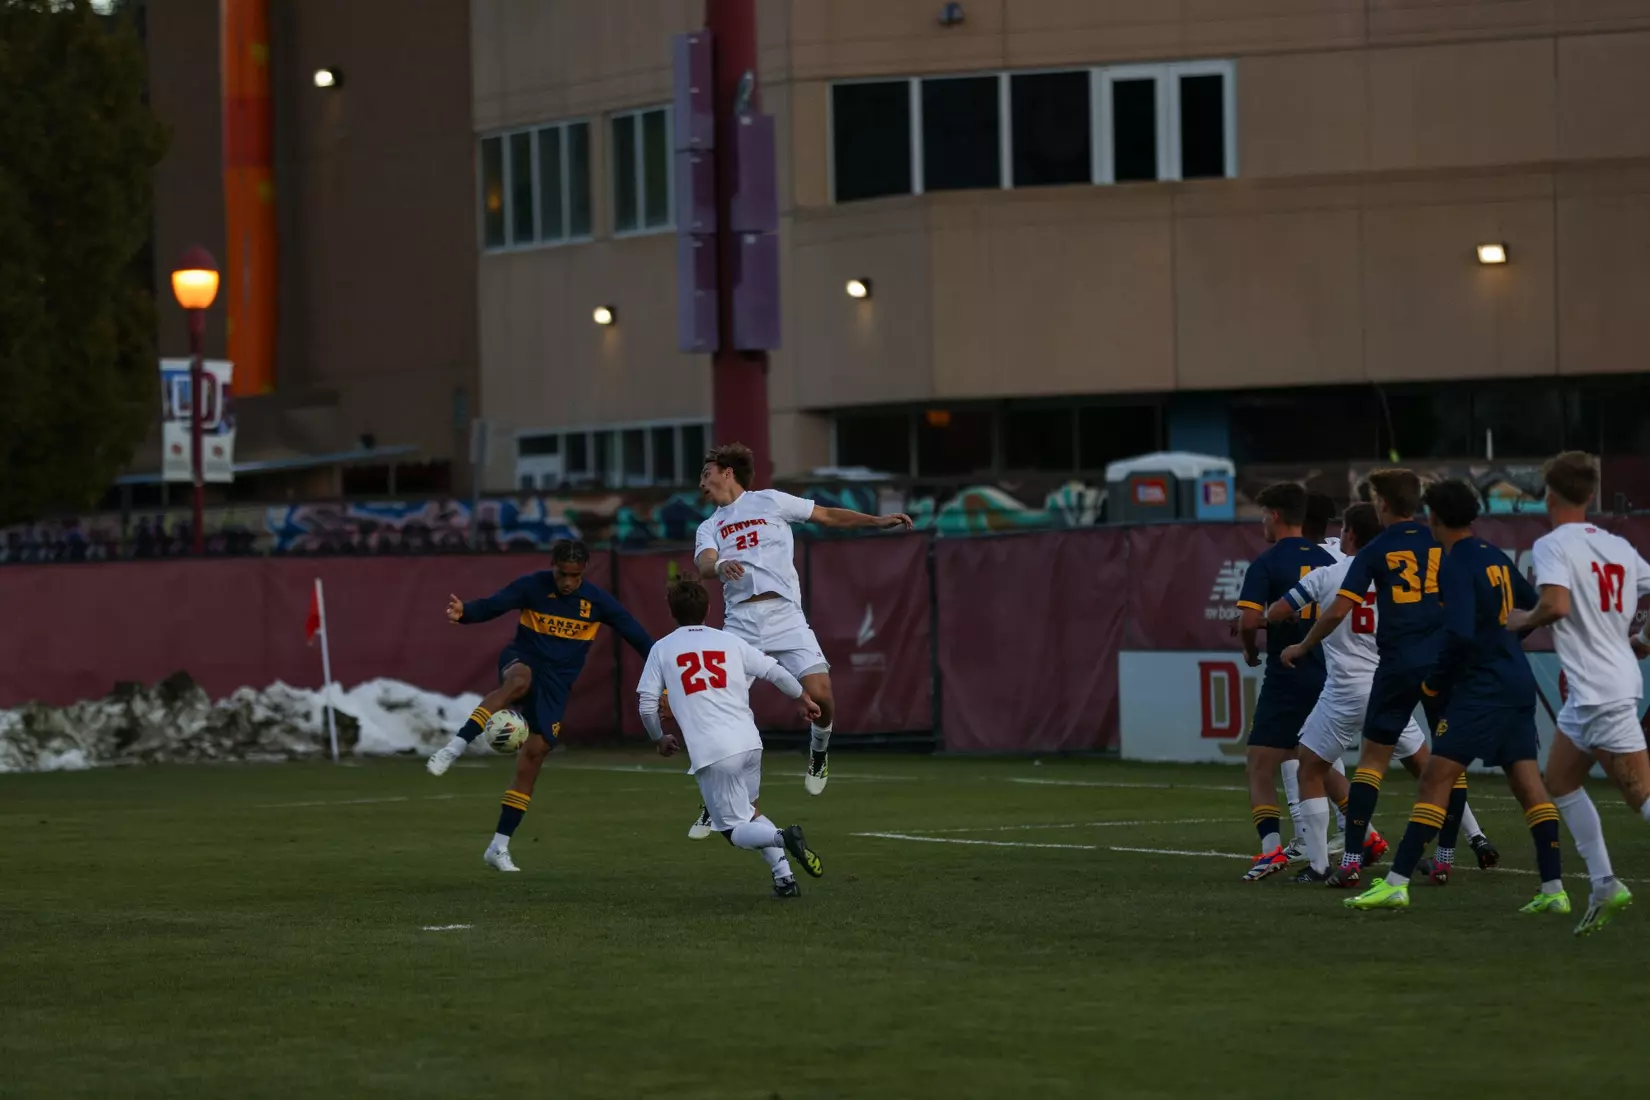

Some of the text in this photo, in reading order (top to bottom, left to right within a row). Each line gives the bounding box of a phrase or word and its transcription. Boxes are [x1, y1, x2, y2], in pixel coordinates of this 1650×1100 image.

[720, 518, 767, 540] DENVER
[736, 531, 758, 551] 23
[538, 616, 589, 631] KANSAS
[549, 626, 578, 636] CITY
[676, 651, 727, 696] 25
